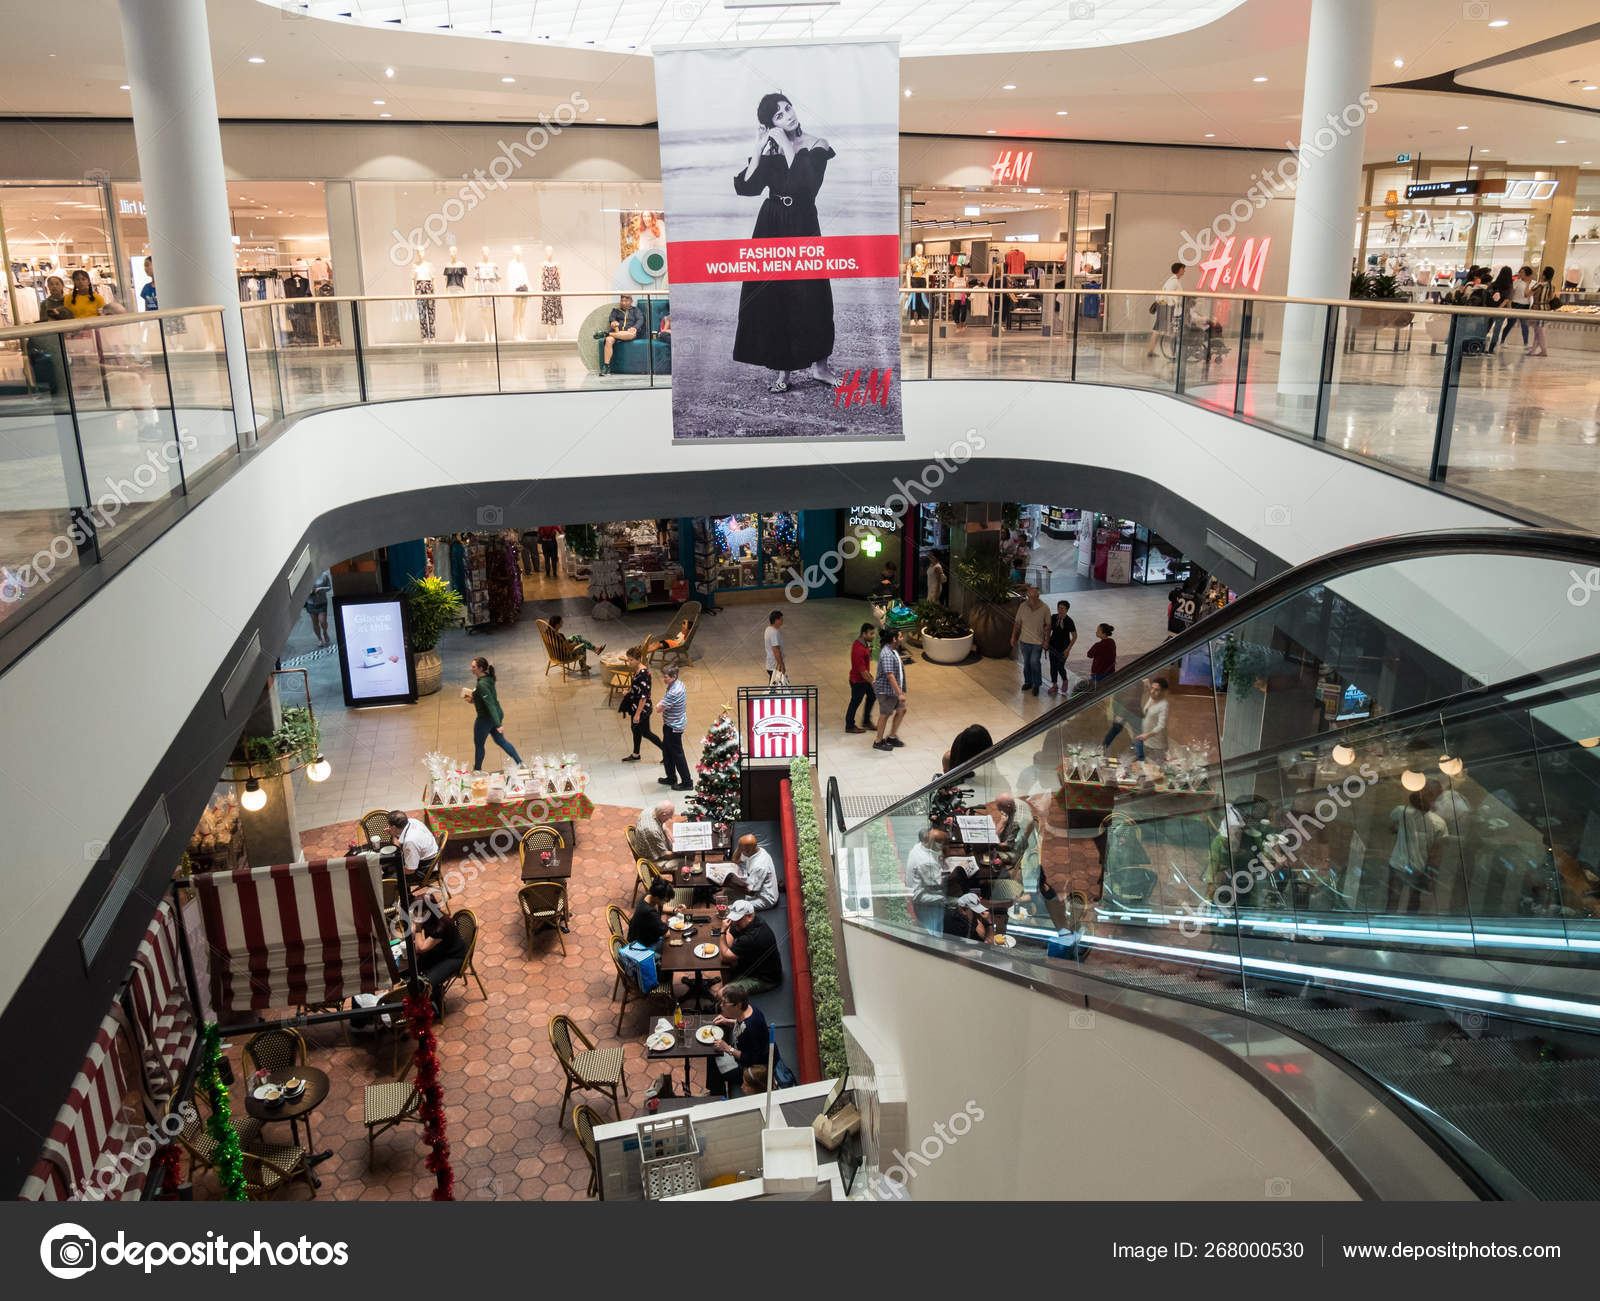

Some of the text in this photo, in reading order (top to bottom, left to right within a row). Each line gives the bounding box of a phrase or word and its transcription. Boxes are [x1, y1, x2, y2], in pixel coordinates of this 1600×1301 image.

[992, 150, 1033, 182] H&M
[739, 246, 825, 259] FASHION FOR
[706, 258, 859, 274] WOMEN, MEN AND KIDS.
[1198, 236, 1271, 292] H&M
[834, 368, 892, 408] H&M
[850, 505, 893, 516] priceline
[849, 516, 896, 532] pharmacy
[1177, 599, 1195, 614] 20
